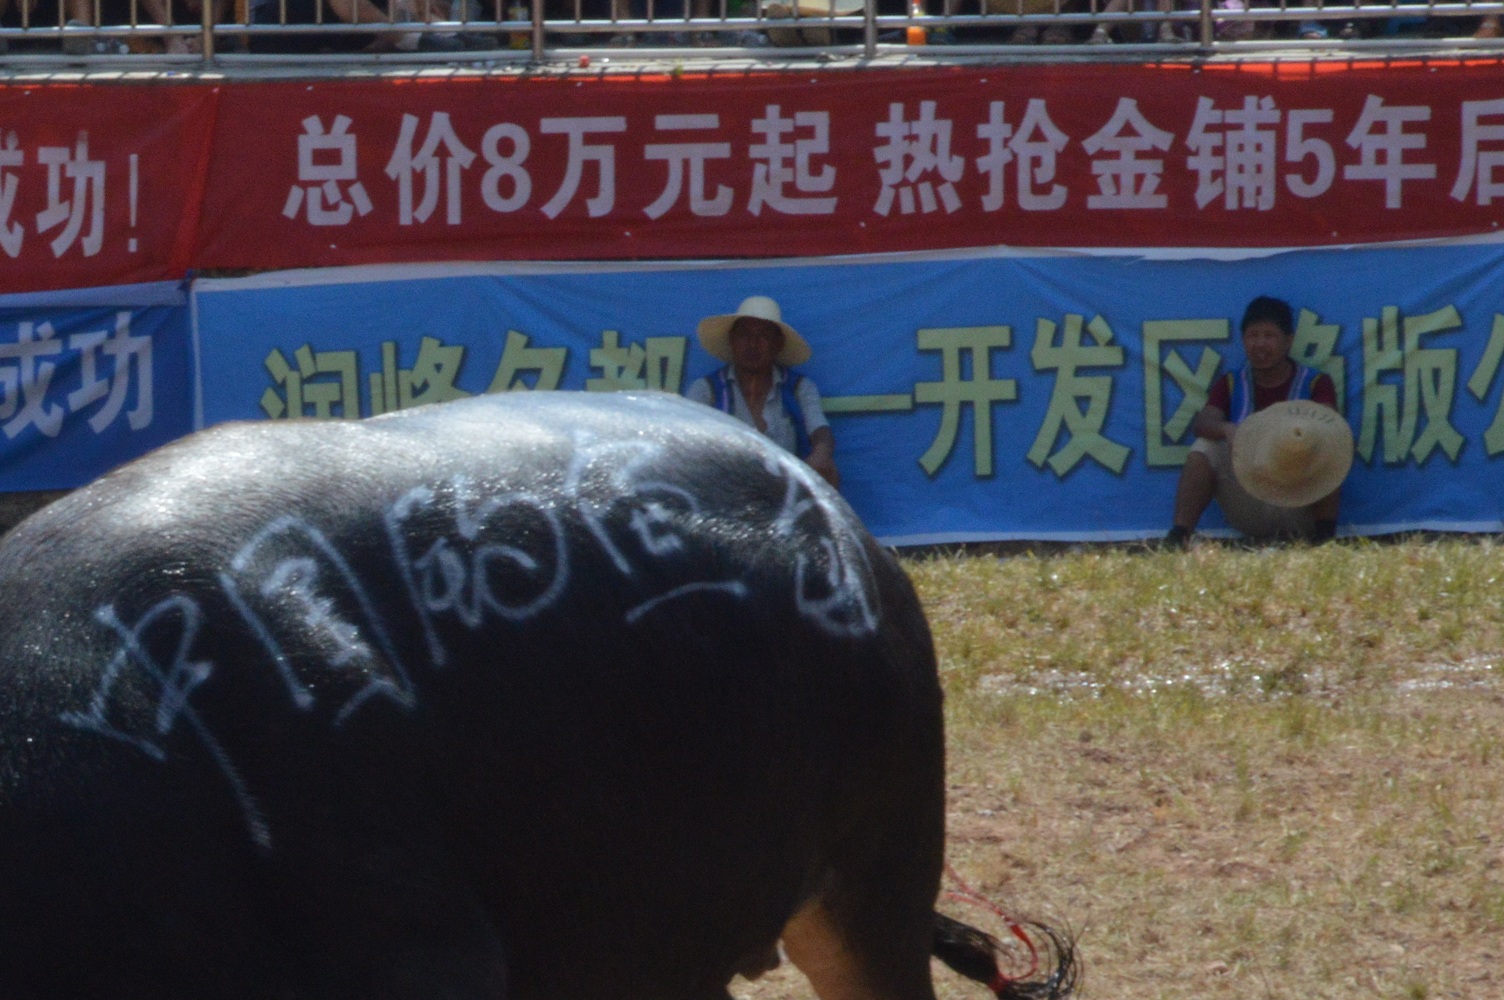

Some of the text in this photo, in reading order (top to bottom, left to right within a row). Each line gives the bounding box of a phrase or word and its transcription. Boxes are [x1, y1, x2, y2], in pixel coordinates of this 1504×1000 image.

[283, 104, 839, 226] 总价8万元起
